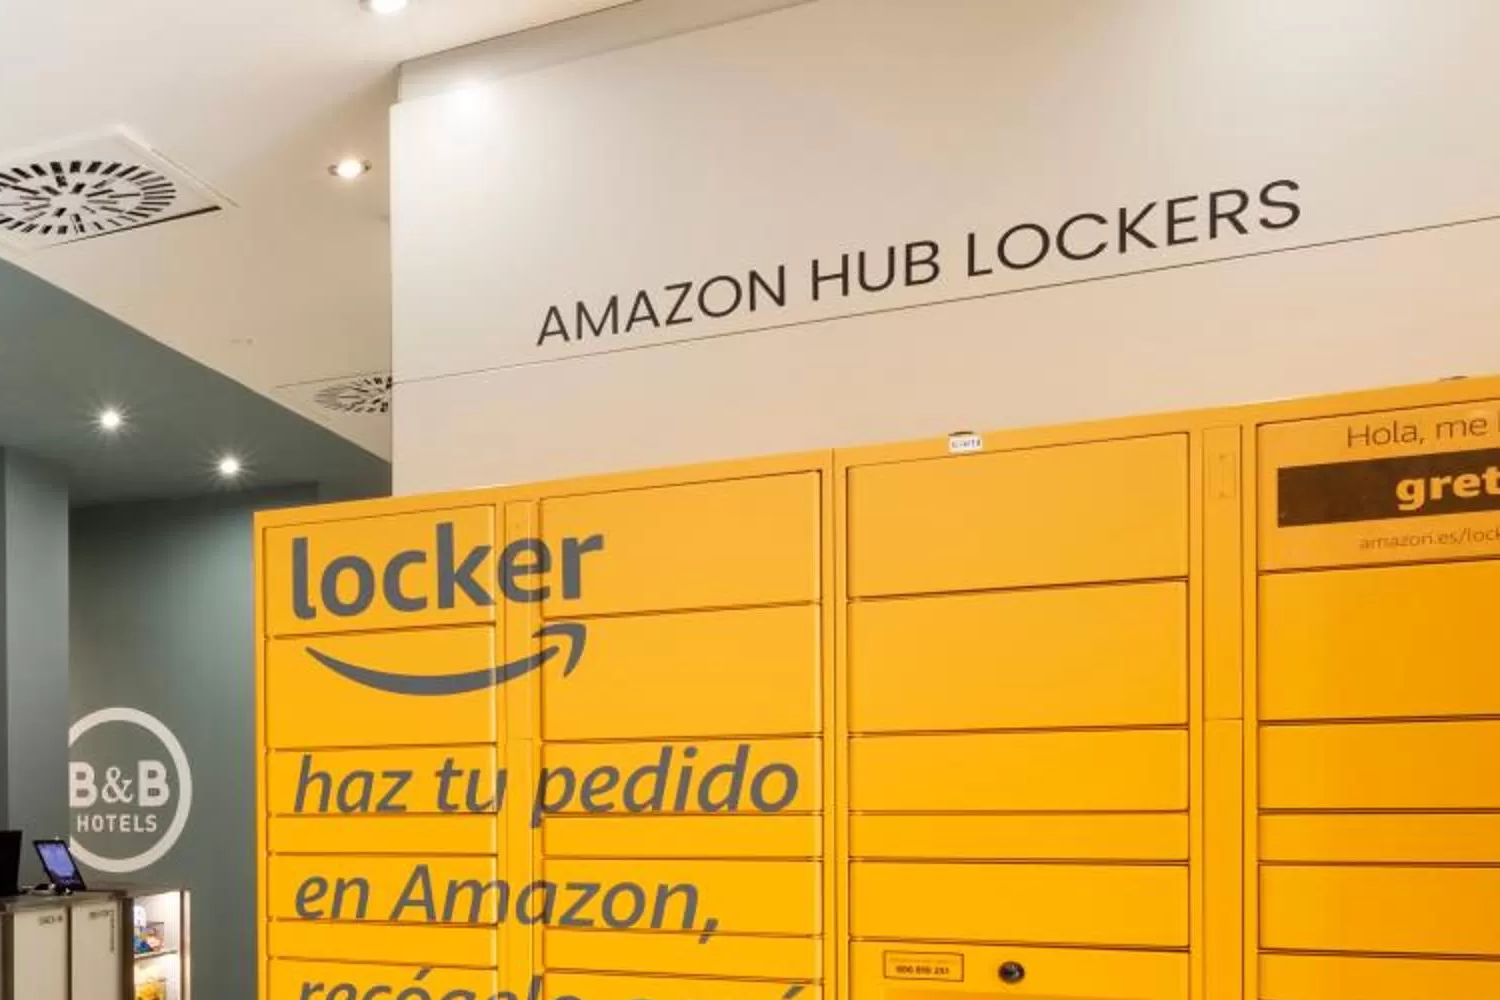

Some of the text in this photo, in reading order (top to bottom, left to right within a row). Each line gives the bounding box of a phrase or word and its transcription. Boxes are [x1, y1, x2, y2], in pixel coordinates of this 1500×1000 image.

[536, 179, 1302, 347] AMAZON HUB LOCKERS
[1347, 420, 1425, 448] Hola,
[1436, 417, 1489, 439] me
[292, 523, 604, 620] locker
[69, 759, 170, 808] B&B
[76, 814, 158, 833] HOTELS
[294, 745, 799, 828] haz tu pedido
[295, 864, 719, 945] en Amazon,
